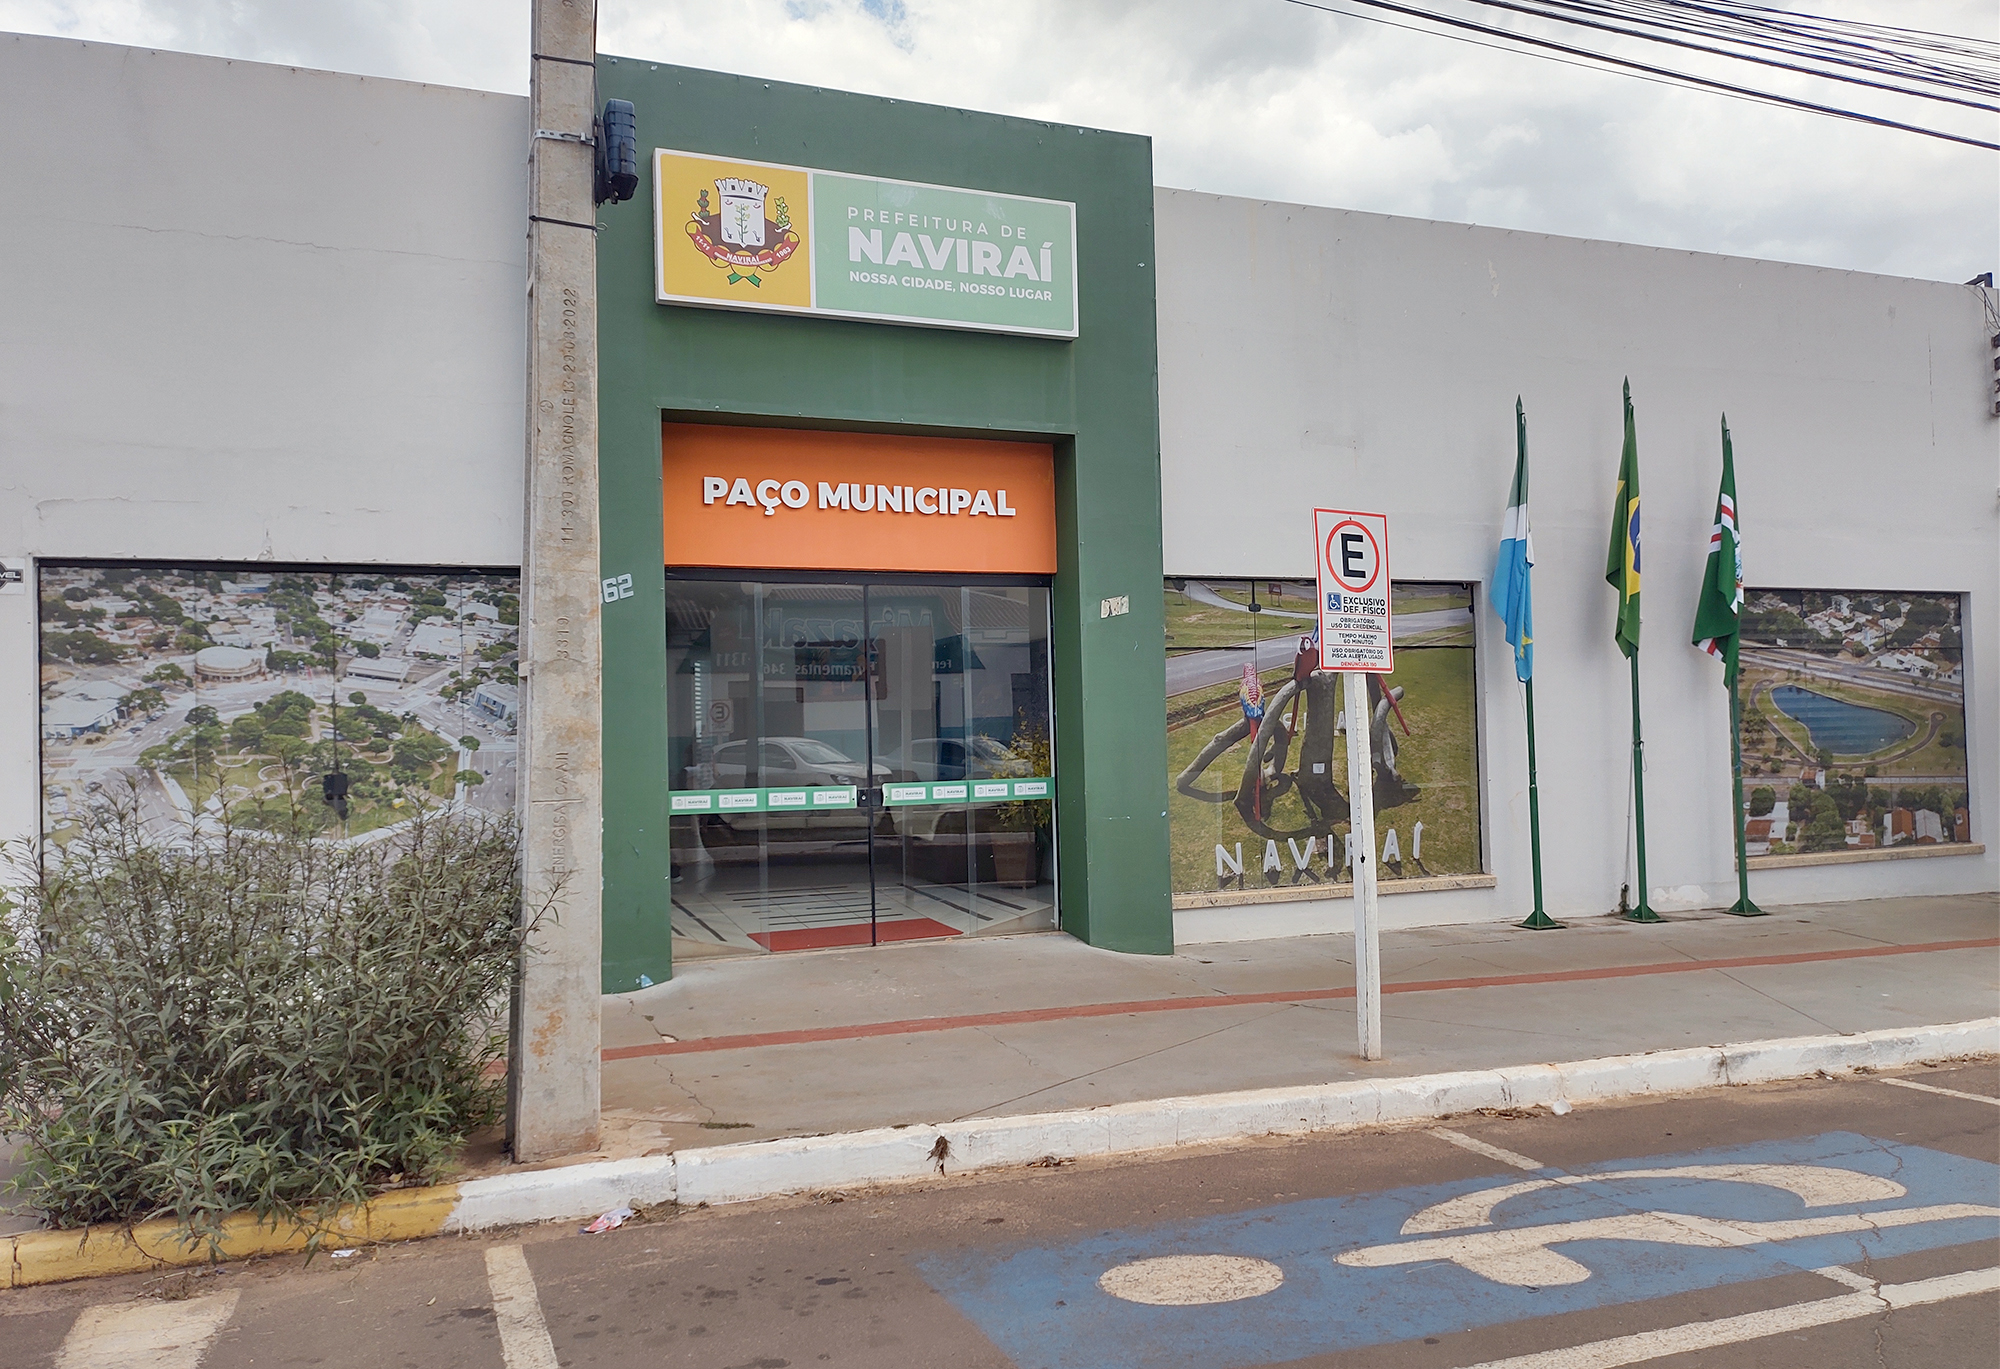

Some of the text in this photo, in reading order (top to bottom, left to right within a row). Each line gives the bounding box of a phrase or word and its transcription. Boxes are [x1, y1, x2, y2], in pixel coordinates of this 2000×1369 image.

[847, 206, 1027, 240] PREFEITURA DE
[848, 226, 1054, 282] NAVIRAÍ
[849, 270, 1053, 301] NOSSA CIDADE, NOSSO LUGAR
[561, 398, 575, 485] ROMAGNOLE
[702, 476, 1017, 517] PAÇO MUNICIPAL
[1341, 533, 1366, 578] E
[602, 573, 634, 603] 62
[1343, 596, 1386, 607] EXCLUSIVO
[1340, 617, 1375, 625] OBRIGATÓRIO
[1343, 604, 1386, 616] DEF. FÍSICO
[552, 805, 567, 875] ENERGISA
